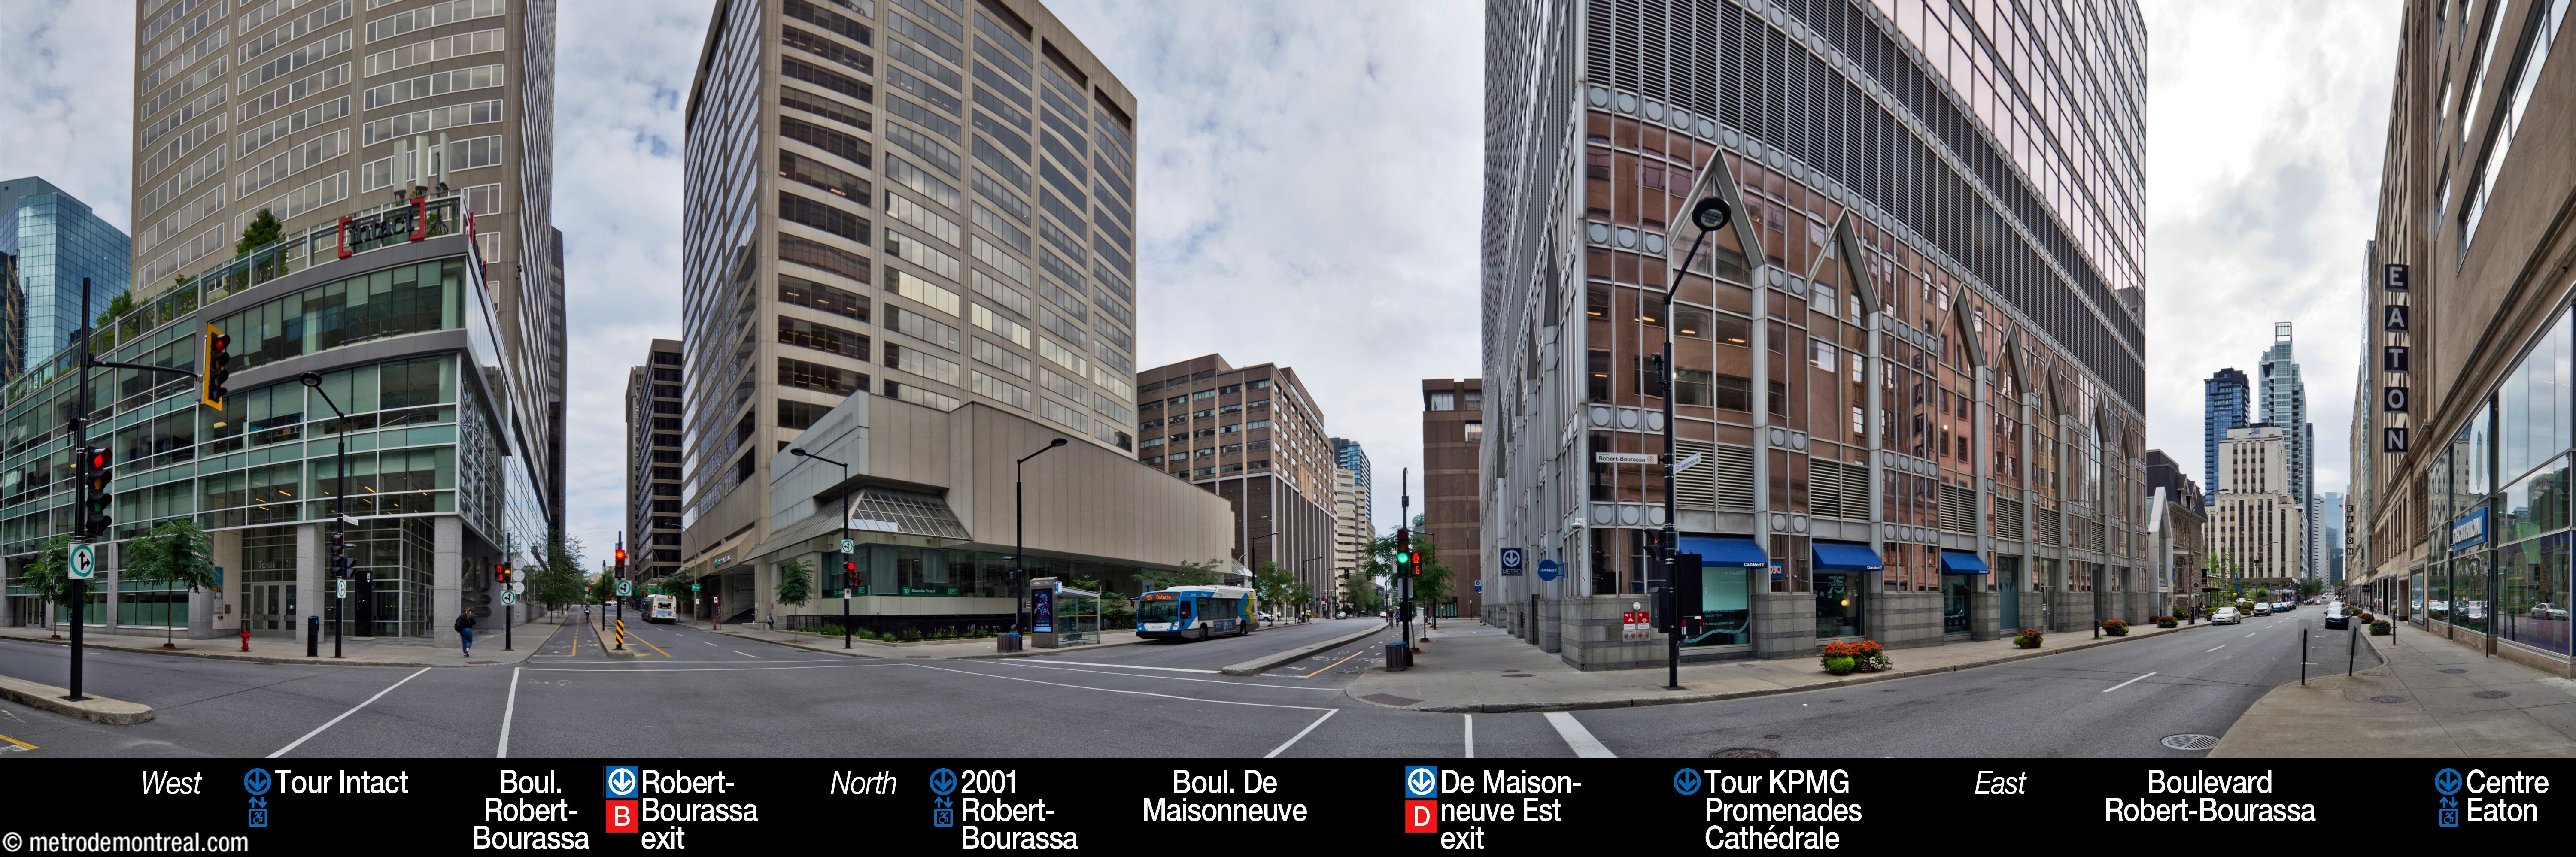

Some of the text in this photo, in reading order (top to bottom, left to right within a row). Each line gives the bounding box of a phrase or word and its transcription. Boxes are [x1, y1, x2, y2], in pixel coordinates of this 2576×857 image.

[2388, 266, 2404, 449] EATON
[1681, 457, 1699, 469] Maisonneuve
[1416, 566, 1419, 574] 6
